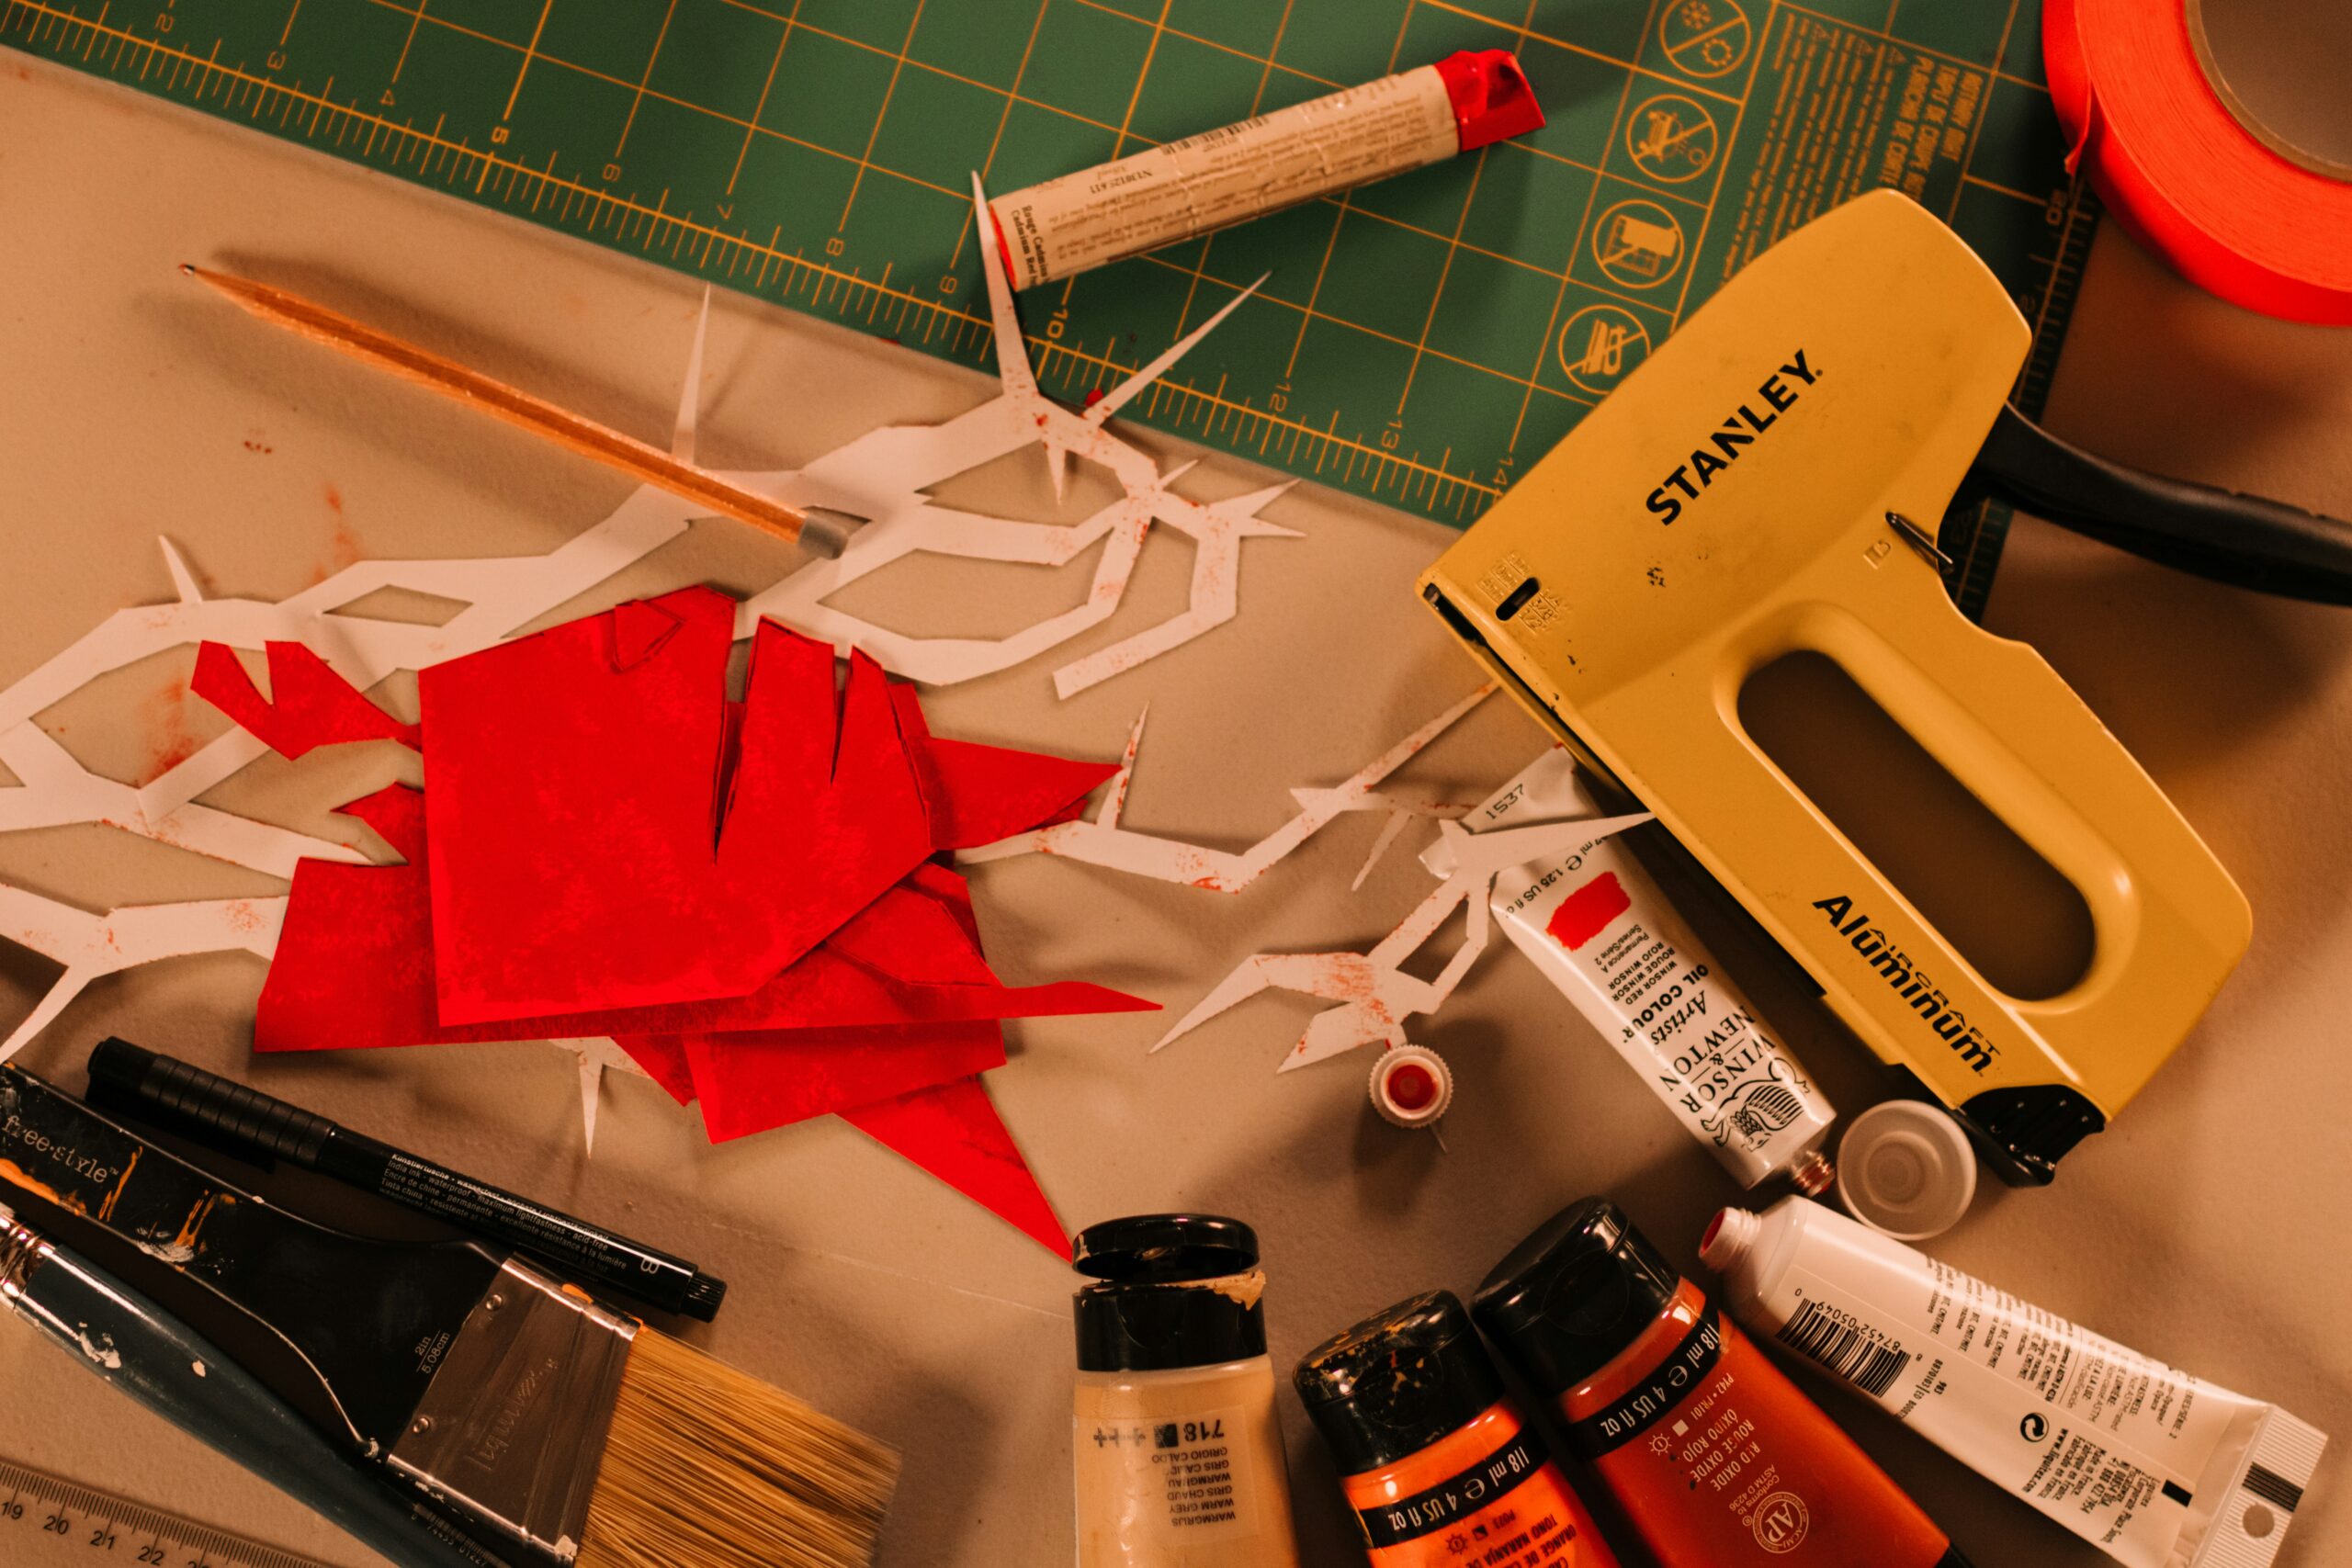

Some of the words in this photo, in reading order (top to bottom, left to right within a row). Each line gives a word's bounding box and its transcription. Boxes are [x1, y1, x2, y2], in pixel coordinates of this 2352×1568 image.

[156, 14, 174, 32] 2
[267, 51, 285, 69] 3
[380, 90, 394, 105] 4
[492, 127, 509, 143] 5
[603, 164, 620, 181] 6
[718, 206, 732, 219] 7
[1020, 205, 1038, 235] Rouge
[1010, 209, 1032, 254] Cadmium
[826, 238, 843, 256] 8
[941, 276, 957, 294] 9
[1046, 309, 1068, 339] 10
[1270, 383, 1290, 412] 12
[1382, 421, 1402, 449] 13
[1645, 348, 1817, 526] STANLEY
[1494, 458, 1513, 485] 14
[1484, 782, 1529, 821] 1537
[1538, 866, 1564, 888] 1.25
[1513, 897, 1524, 909] fl
[1521, 883, 1542, 903] US
[1600, 921, 1643, 962] Series/Série
[1606, 930, 1649, 970] Permanence
[1639, 939, 1665, 963] ROJO
[1592, 956, 1602, 966] 2
[1600, 964, 1610, 975] A
[1643, 944, 1676, 975] ROUGE
[1606, 958, 1642, 991] WINSOR
[1611, 969, 1646, 1003] WINSOR
[1642, 957, 1678, 991] WINSOR
[1680, 961, 1710, 989] OIL
[1812, 896, 1992, 1073] Aluminum
[1623, 987, 1645, 1007] RED
[1870, 928, 2001, 1055] AIRCRAFT
[1656, 1001, 1756, 1095] NEWTON
[1707, 1051, 1725, 1069] &
[1678, 1027, 1776, 1119] WINSOR
[379, 1177, 401, 1190] Tinta
[401, 1185, 424, 1200] china
[429, 1197, 469, 1218] resistente
[387, 1159, 407, 1173] India
[407, 1168, 421, 1179] ink
[427, 1176, 470, 1198] waterproof
[476, 1194, 515, 1215] maximum
[514, 1209, 566, 1235] lightfastness
[571, 1232, 608, 1251] acid-free
[382, 1168, 407, 1183] Encre
[407, 1178, 418, 1188] de
[418, 1181, 441, 1197] chine
[446, 1193, 493, 1217] permanente
[499, 1213, 540, 1235] excellente
[587, 1247, 597, 1258] la
[596, 1251, 628, 1269] lumière
[1793, 1287, 1803, 1297] 0
[1815, 1299, 1858, 1328] 05049
[413, 1334, 432, 1356] 2in
[1696, 1322, 1724, 1350] 118
[1859, 1322, 1902, 1351] 87452
[1683, 1342, 1709, 1368] ml
[1650, 1382, 1669, 1403] 4
[1713, 1372, 1736, 1394] PY42
[1933, 1380, 1947, 1395] 983
[1618, 1407, 1636, 1427] fl
[1631, 1393, 1656, 1418] US
[1182, 1419, 1224, 1441] 718
[1599, 1415, 1622, 1438] oz
[1704, 1407, 1740, 1442] ÓXIDO
[1719, 1418, 1756, 1453] ROUGE
[1190, 1447, 1227, 1461] GRIGIO
[1504, 1444, 1531, 1473] 118
[1679, 1433, 1710, 1462] ROJO
[2058, 1434, 2084, 1468] Fabricado
[2070, 1439, 2097, 1472] Fabriqué
[2089, 1447, 2107, 1467] Made
[1204, 1459, 1228, 1472] GRIS
[1487, 1460, 1510, 1487] ml
[1689, 1448, 1724, 1482] OXYDE
[2021, 1426, 2072, 1497] www.liquitex.com
[2053, 1467, 2064, 1477] en
[2085, 1465, 2096, 1475] in
[1708, 1459, 1742, 1491] OXIDE
[1751, 1463, 1778, 1488] ASTM
[2067, 1470, 2077, 1480] en
[1167, 1488, 1204, 1499] CHAUD
[1206, 1485, 1232, 1496] GRIS
[1444, 1490, 1459, 1511] 4
[1727, 1491, 1749, 1511] 4236
[1743, 1473, 1781, 1508] Conforms
[1746, 1484, 1756, 1495] D
[2122, 1476, 2149, 1511] Corporate
[1, 1501, 23, 1520] 19
[1169, 1503, 1197, 1512] GREY
[1201, 1497, 1234, 1510] WARM
[1421, 1496, 1445, 1522] US
[1736, 1505, 1747, 1516] to
[43, 1515, 70, 1535] 20
[1386, 1509, 1407, 1530] oz
[1407, 1506, 1422, 1528] fl
[1528, 1513, 1558, 1539] TONO
[1758, 1502, 1802, 1545] AP
[2114, 1509, 2132, 1530] Place
[89, 1529, 116, 1551] 21
[1480, 1529, 1531, 1568] NARANJA
[1537, 1523, 1579, 1557] ORANGE
[137, 1545, 165, 1567] 22
[1522, 1550, 1541, 1567] DE
